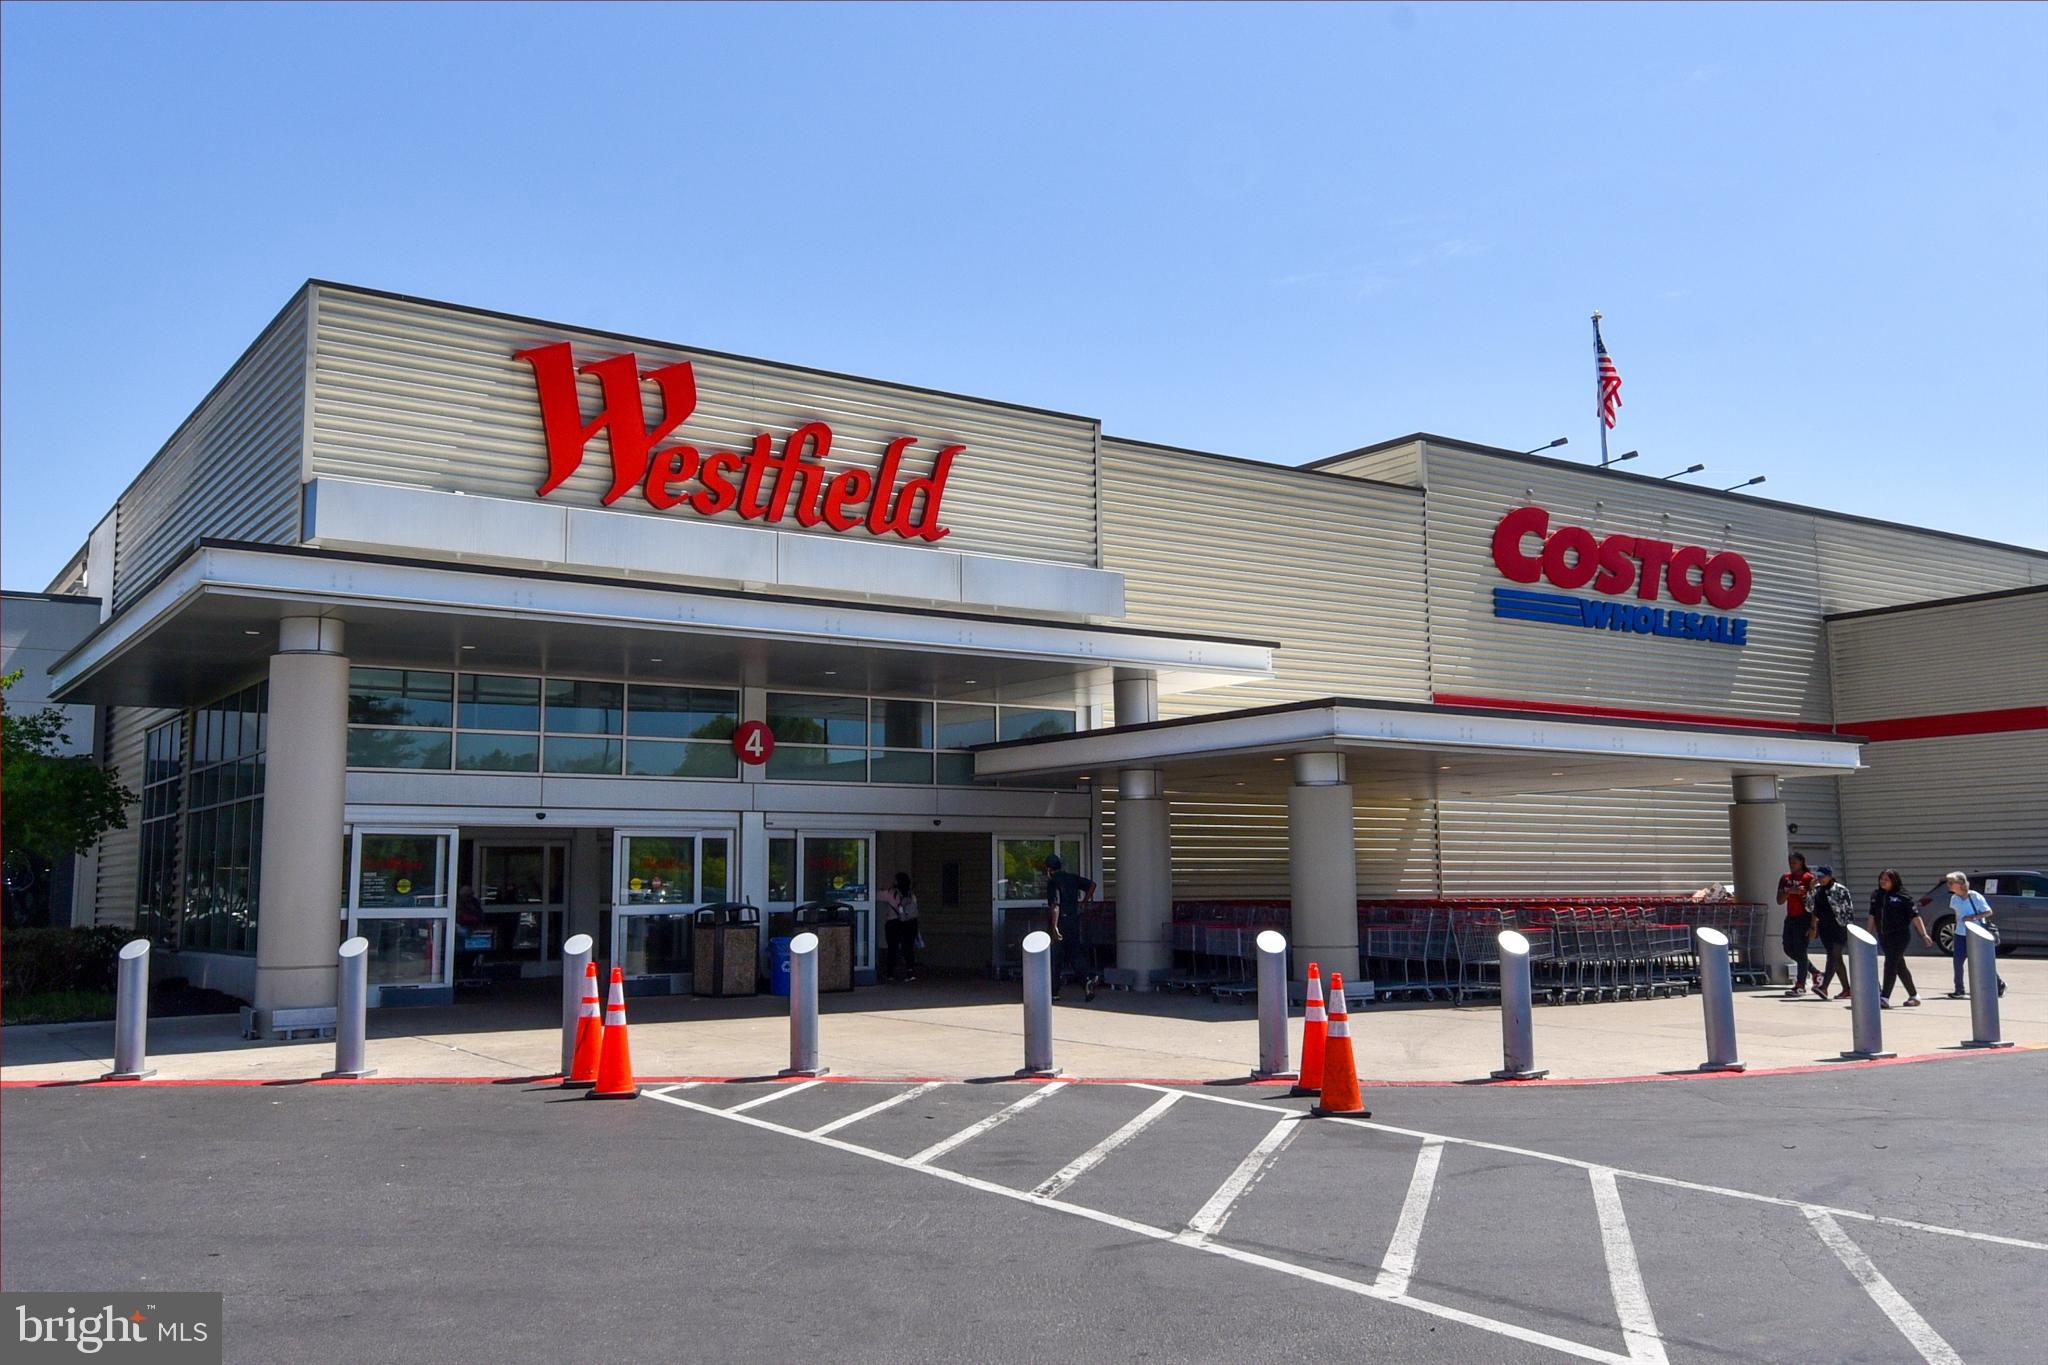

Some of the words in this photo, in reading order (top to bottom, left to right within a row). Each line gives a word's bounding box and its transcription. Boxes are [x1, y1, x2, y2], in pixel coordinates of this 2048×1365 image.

[512, 341, 967, 542] Westfield
[1492, 506, 1753, 610] COSTCO
[1580, 598, 1748, 646] WHOLESALE
[745, 729, 764, 757] 4
